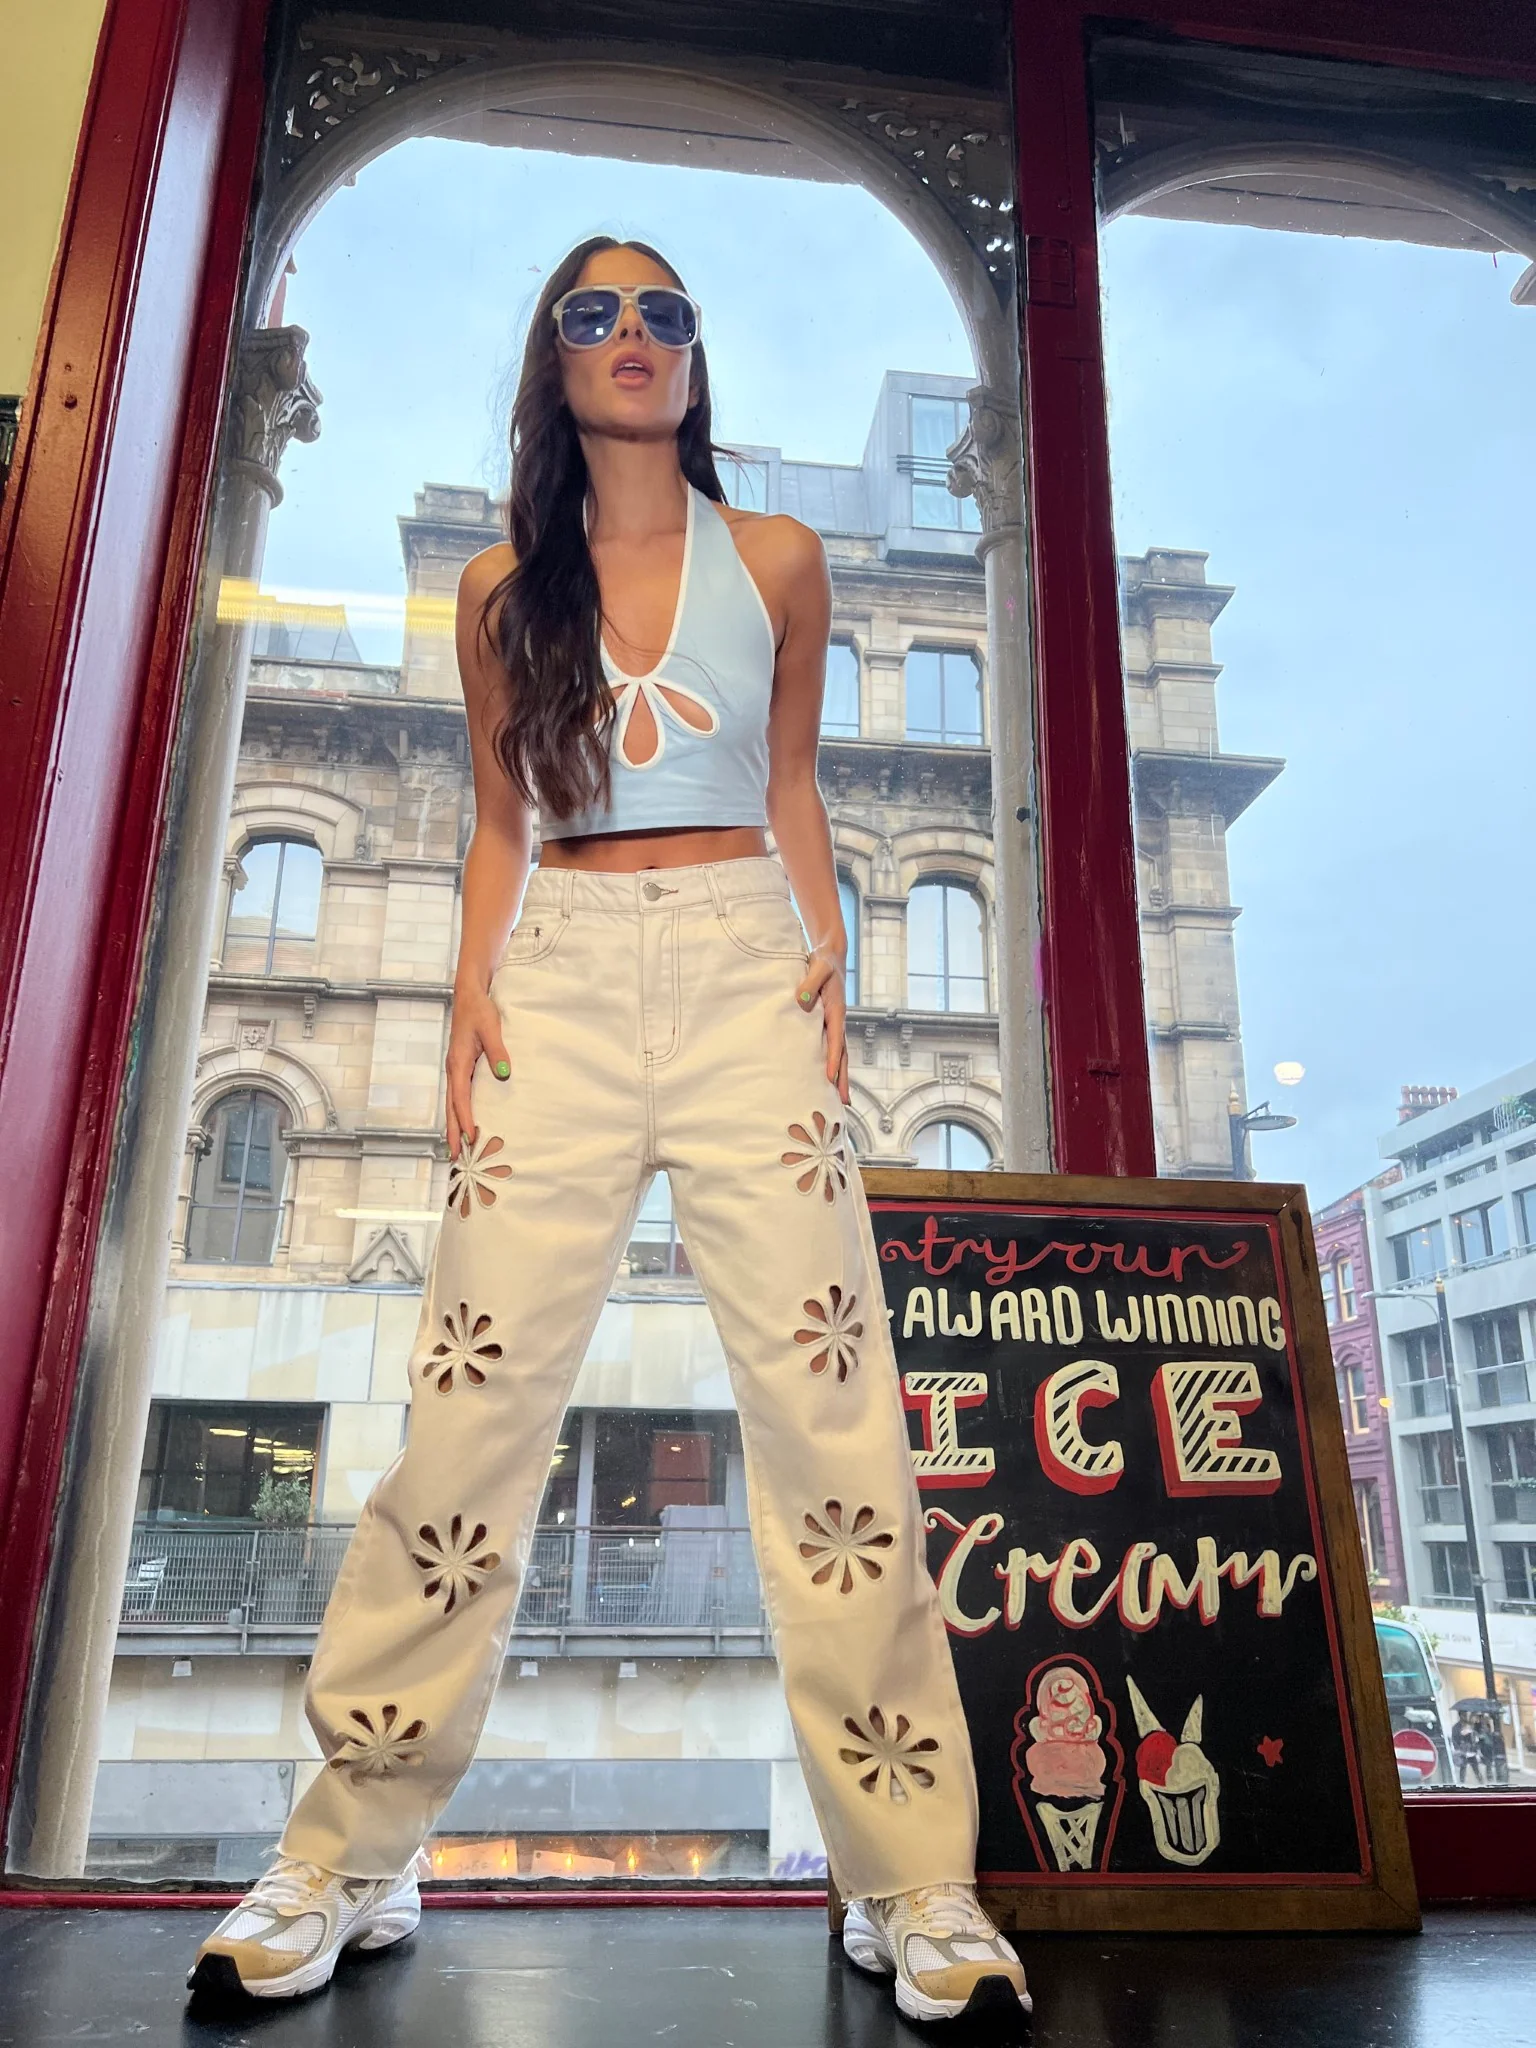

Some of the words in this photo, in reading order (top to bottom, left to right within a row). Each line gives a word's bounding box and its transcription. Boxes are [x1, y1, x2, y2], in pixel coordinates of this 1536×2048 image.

[882, 1216, 1052, 1285] try
[1053, 1240, 1250, 1282] our
[903, 1286, 1083, 1344] AWARD
[1097, 1290, 1286, 1350] WINNING
[904, 1360, 1282, 1497] ICE
[924, 1508, 1316, 1633] Cream
